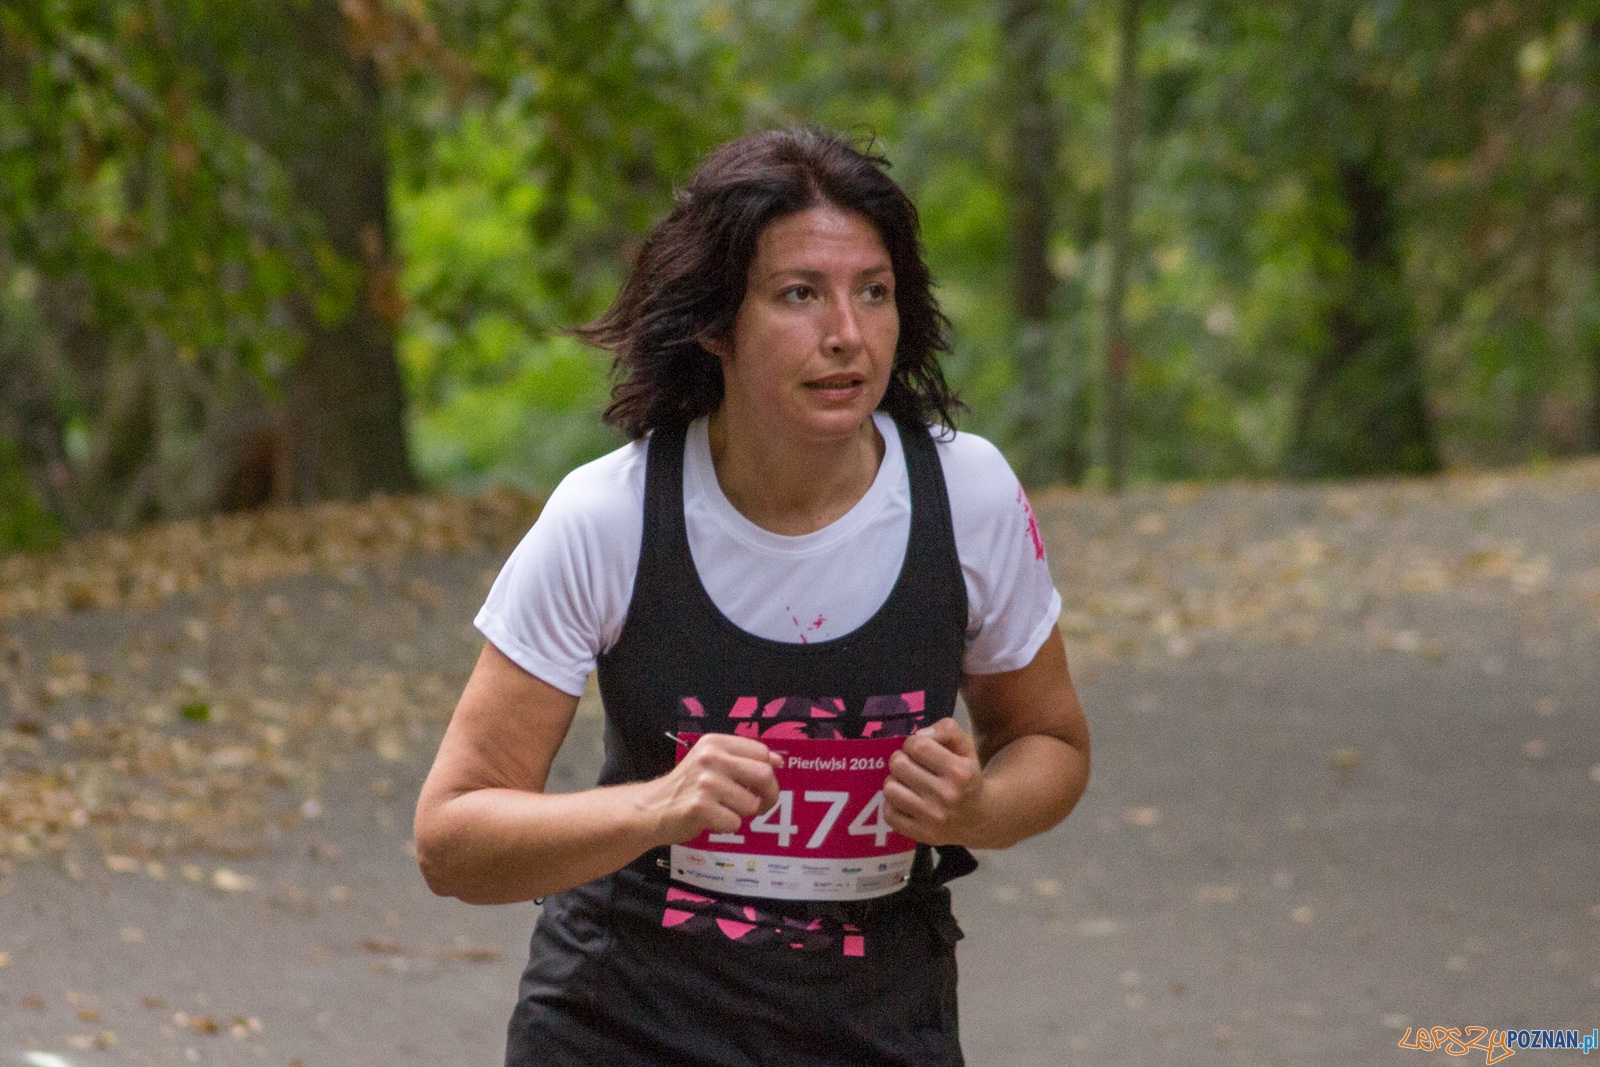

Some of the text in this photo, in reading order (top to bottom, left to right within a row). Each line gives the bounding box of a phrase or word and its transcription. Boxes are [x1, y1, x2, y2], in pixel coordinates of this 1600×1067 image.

[788, 756, 847, 771] Pier(w)si
[849, 757, 885, 770] 2016
[708, 790, 894, 849] 474
